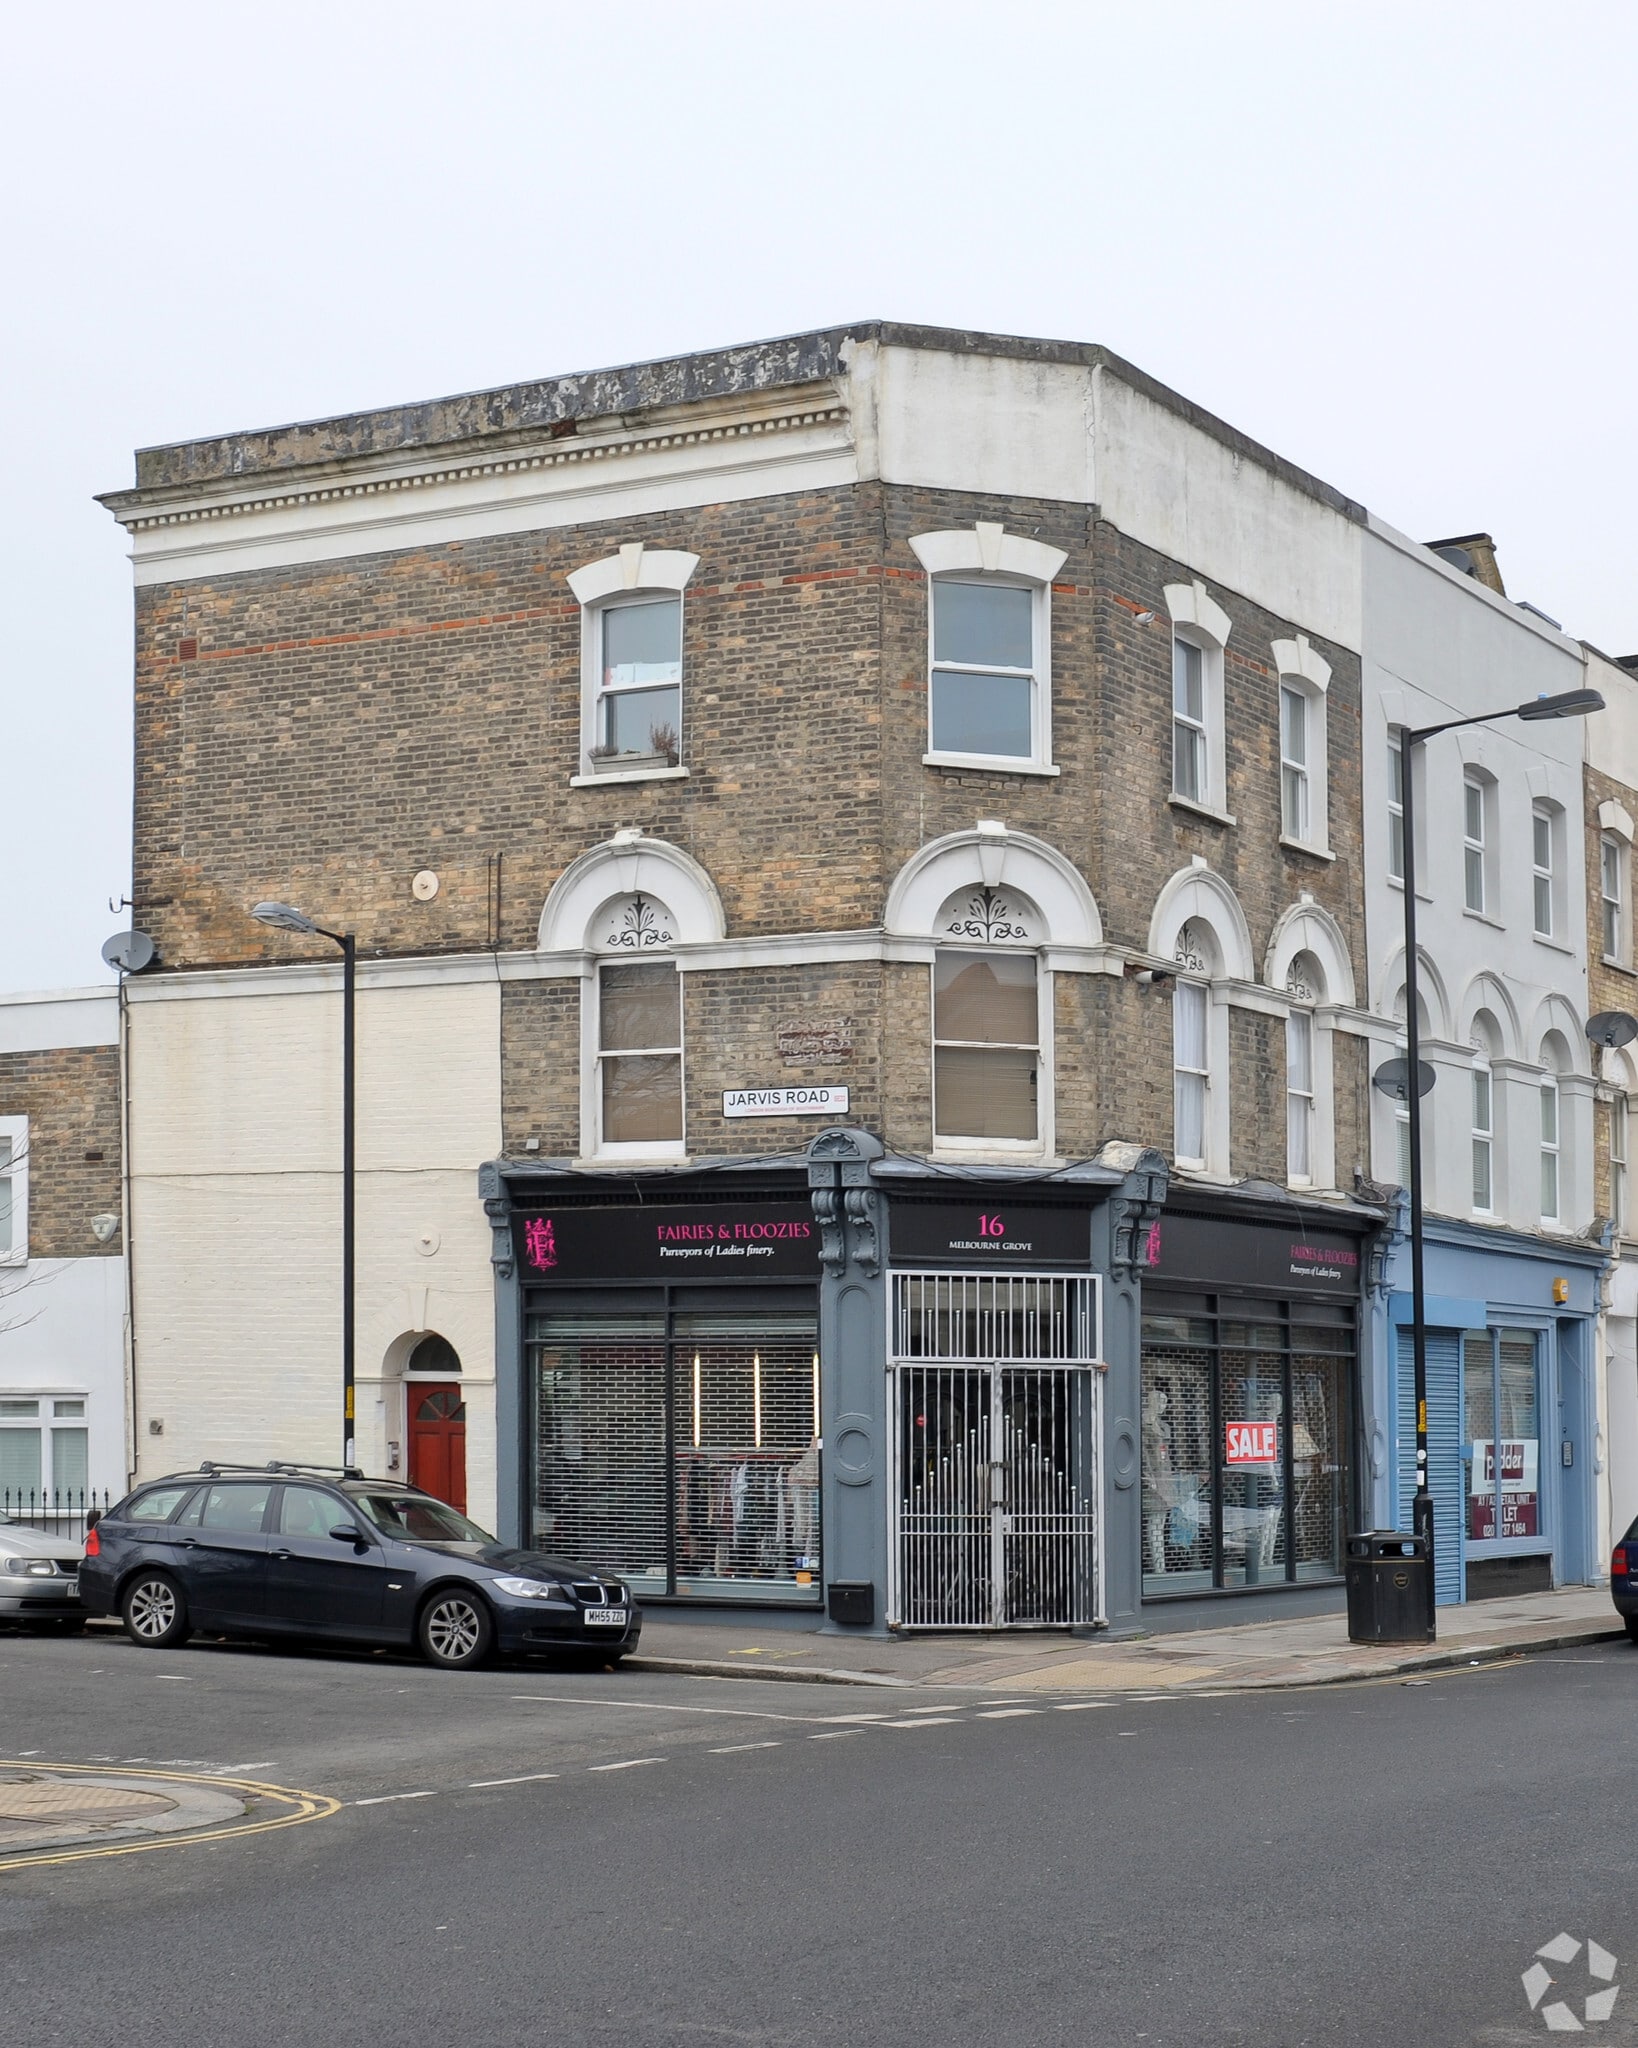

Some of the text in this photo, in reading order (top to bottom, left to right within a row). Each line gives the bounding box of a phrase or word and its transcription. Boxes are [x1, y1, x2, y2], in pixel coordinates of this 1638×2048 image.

[728, 1092, 781, 1106] JARVIS
[786, 1090, 830, 1104] ROAD
[657, 1222, 811, 1241] FAIRIES & FLOOZIES
[978, 1214, 1005, 1237] 16
[659, 1246, 703, 1259] Purveyors
[704, 1244, 715, 1258] of
[716, 1244, 745, 1256] Ladies
[949, 1241, 1033, 1251] MELBOURNE GROVE
[1228, 1427, 1274, 1458] SALE
[1486, 1445, 1522, 1481] pdder
[1516, 1493, 1530, 1505] UNIT
[1503, 1506, 1518, 1522] LET
[588, 1610, 611, 1622] MH55
